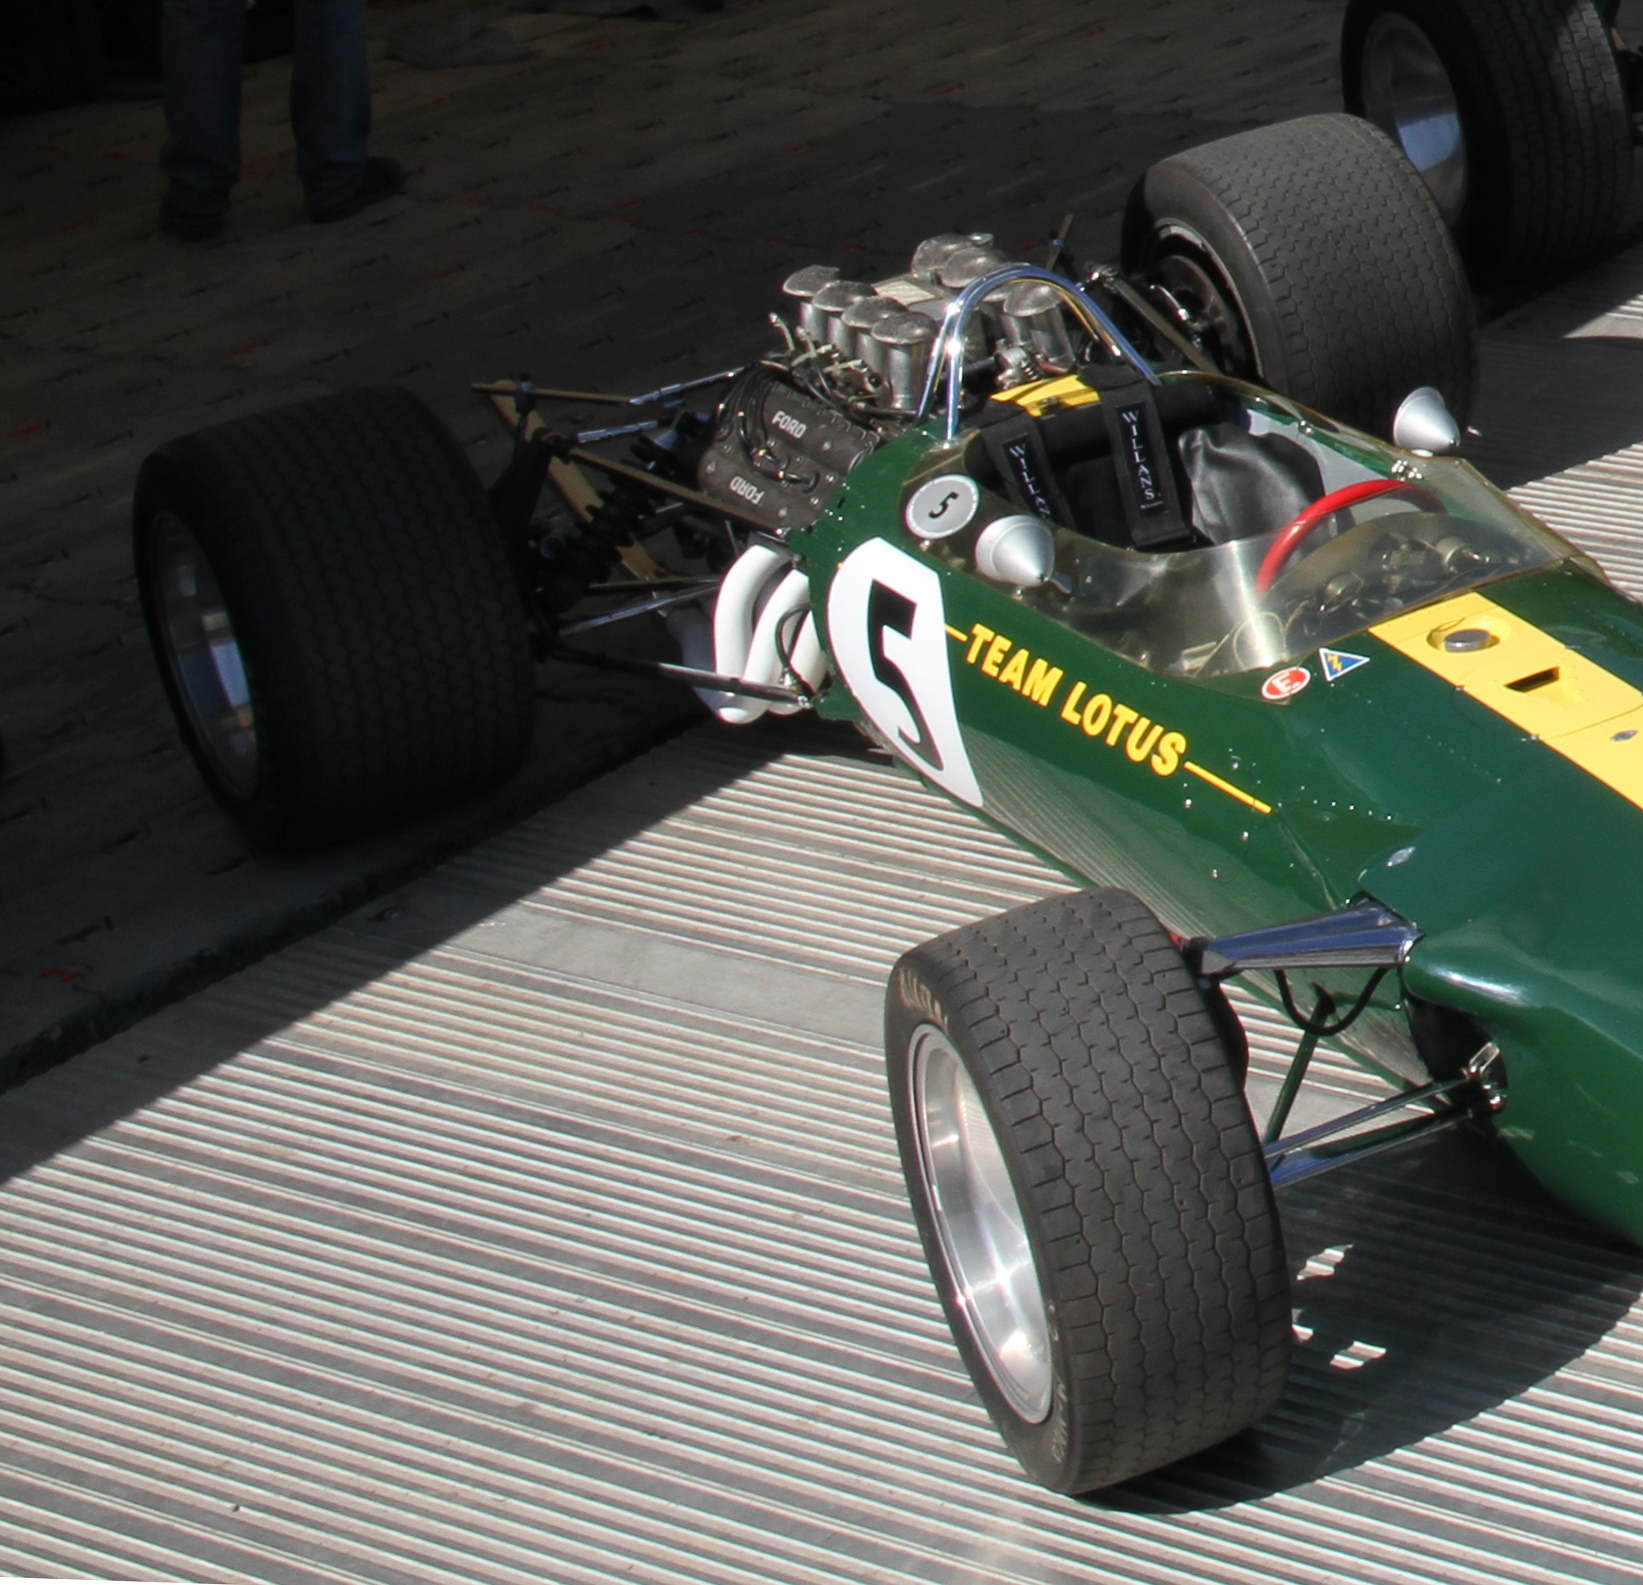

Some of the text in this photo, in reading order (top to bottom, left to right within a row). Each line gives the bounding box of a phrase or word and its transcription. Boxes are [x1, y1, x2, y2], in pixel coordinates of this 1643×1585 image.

[771, 410, 808, 439] FORD
[1121, 409, 1155, 500] WILLANS
[729, 475, 766, 505] FORD
[927, 491, 959, 520] 5
[1008, 442, 1051, 516] WILLAN
[867, 577, 945, 771] 5
[962, 621, 1188, 778] TEAM LOTUS
